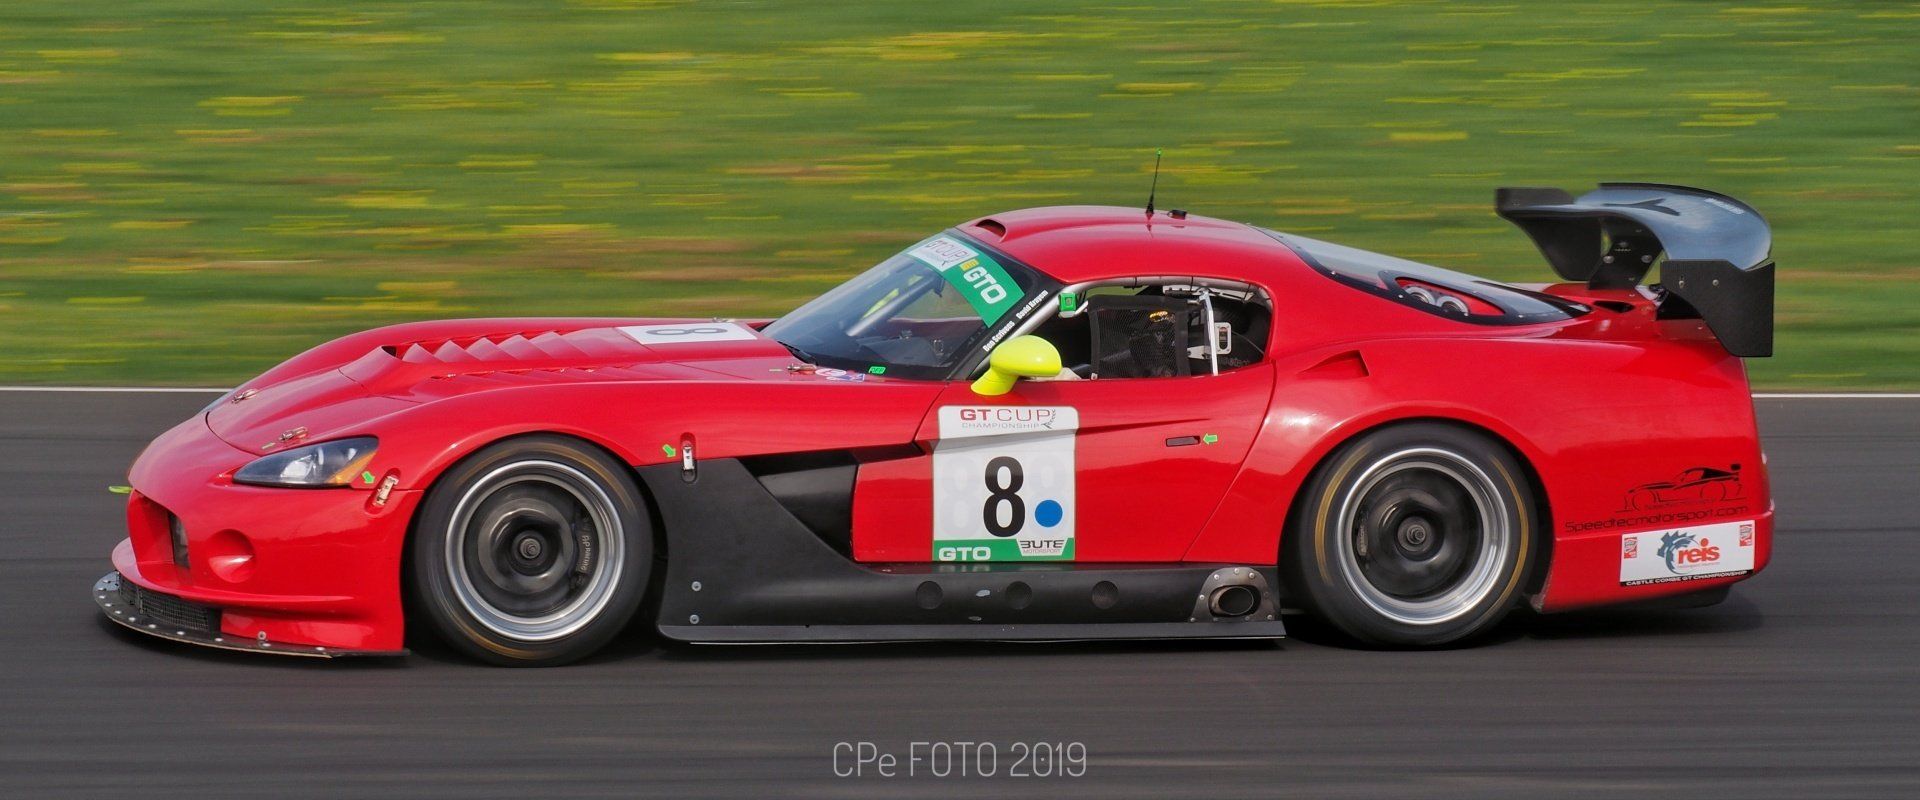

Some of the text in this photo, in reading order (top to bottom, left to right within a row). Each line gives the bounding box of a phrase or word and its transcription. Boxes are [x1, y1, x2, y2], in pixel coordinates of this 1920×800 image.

[936, 244, 968, 261] CUP
[963, 266, 1006, 304] GTO
[1015, 304, 1032, 319] David
[646, 327, 728, 336] 8
[960, 409, 1050, 422] GT CUP
[962, 422, 1040, 430] CHAMPIONSHIP
[983, 456, 1026, 538] 8
[1564, 505, 1748, 533] Speedtecmotorsport.com
[1019, 540, 1065, 549] BUTE
[1678, 537, 1720, 565] reis
[938, 547, 991, 561] GTO
[1693, 570, 1747, 579] CHAMPIONSHIP
